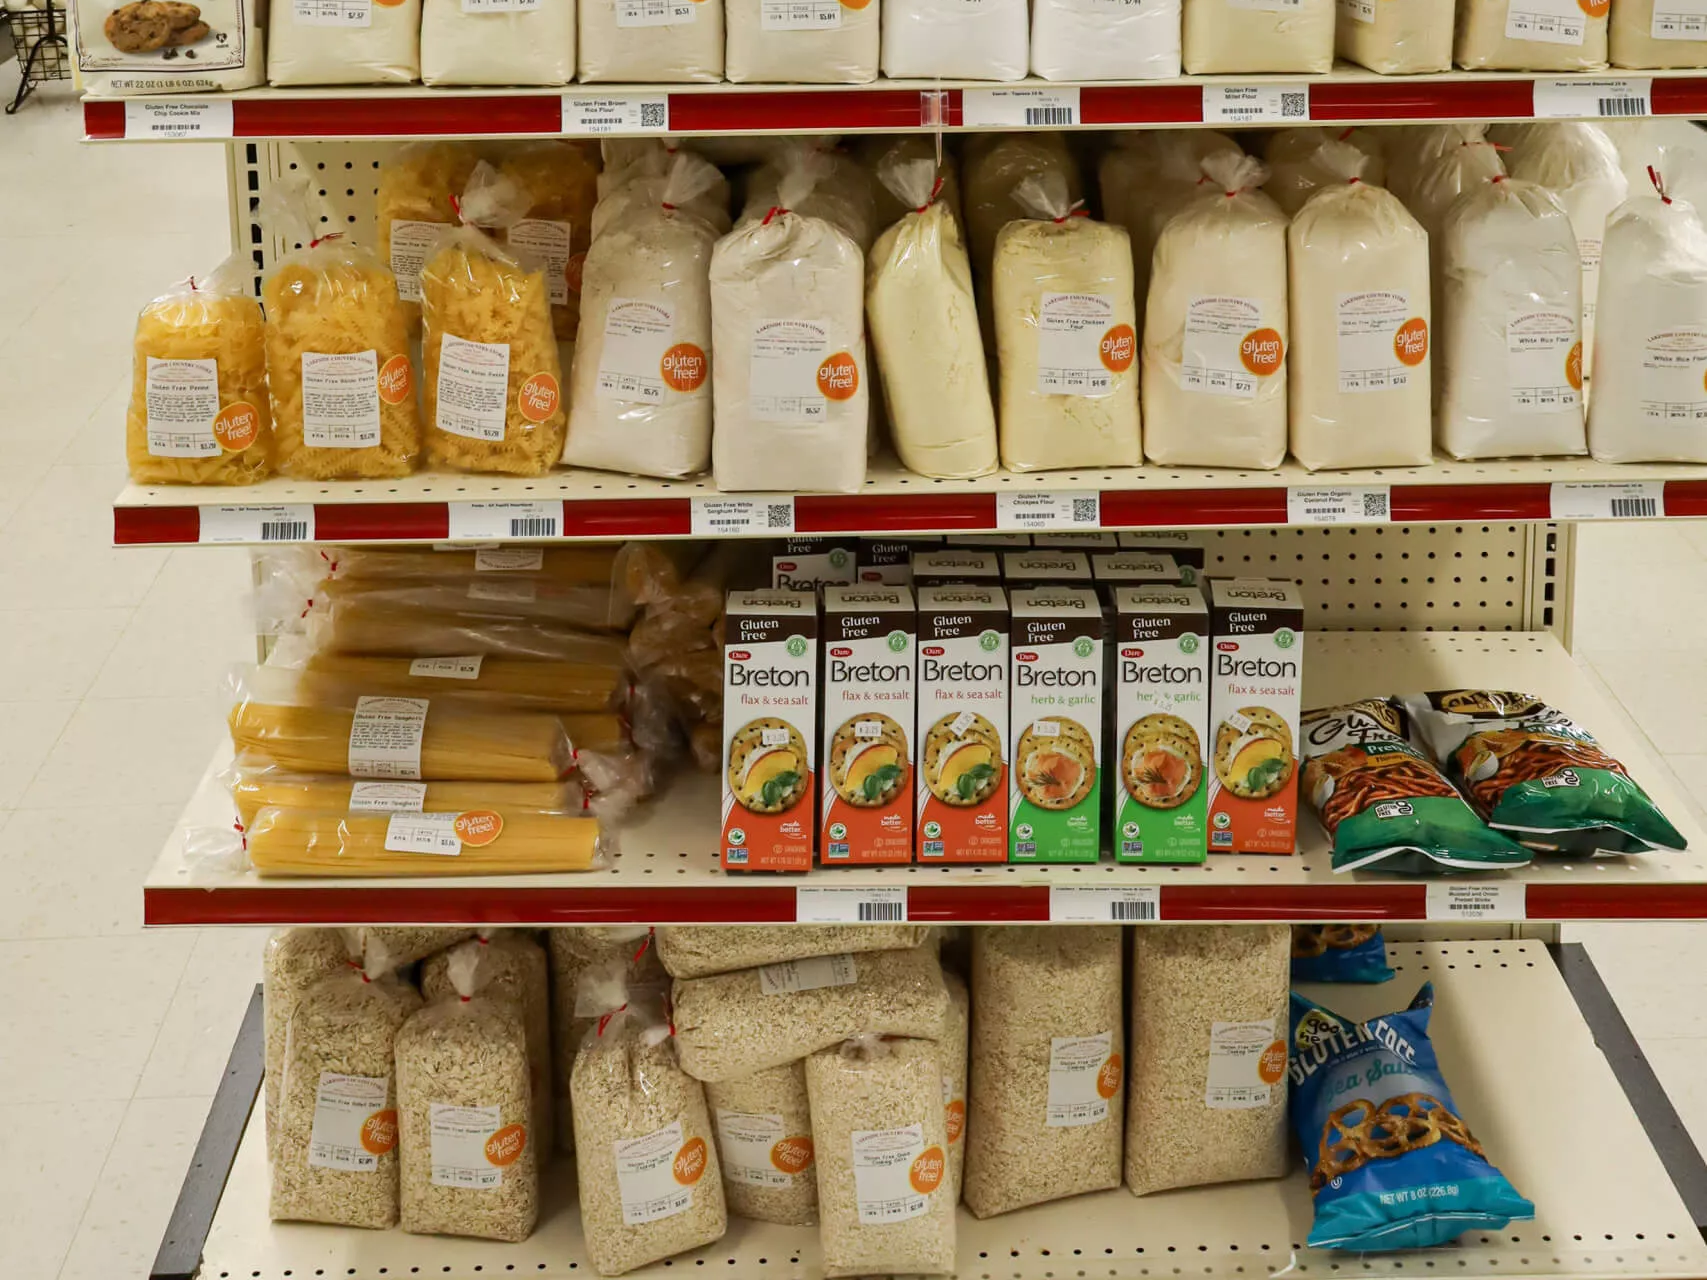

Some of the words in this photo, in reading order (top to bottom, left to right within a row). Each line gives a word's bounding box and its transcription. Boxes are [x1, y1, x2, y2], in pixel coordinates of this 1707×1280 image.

[1102, 336, 1133, 354] gluten
[214, 412, 254, 435] gluten
[740, 619, 779, 631] Gluten
[1027, 621, 1066, 632] Gluten
[741, 630, 767, 641] Free
[1028, 632, 1054, 643] Free
[1019, 653, 1036, 662] Dare
[1218, 654, 1297, 678] Breton
[730, 663, 810, 687] Breton
[831, 659, 911, 683] Breton
[924, 659, 1003, 683] Breton
[1017, 664, 1097, 687] Breton
[1122, 661, 1202, 684] Breton
[741, 693, 760, 705] flax
[763, 695, 770, 705] &
[771, 696, 789, 705] sea
[791, 694, 809, 705] salt
[1031, 694, 1056, 705] herb
[1057, 696, 1066, 705] &
[1068, 694, 1096, 707] garlic
[456, 813, 496, 831] gluten
[1289, 1022, 1375, 1087] GLUTEN
[915, 1158, 942, 1174] gluten
[1380, 1192, 1396, 1205] NET
[1396, 1190, 1409, 1202] WT
[1410, 1190, 1417, 1201] 8
[1418, 1187, 1428, 1198] OZ
